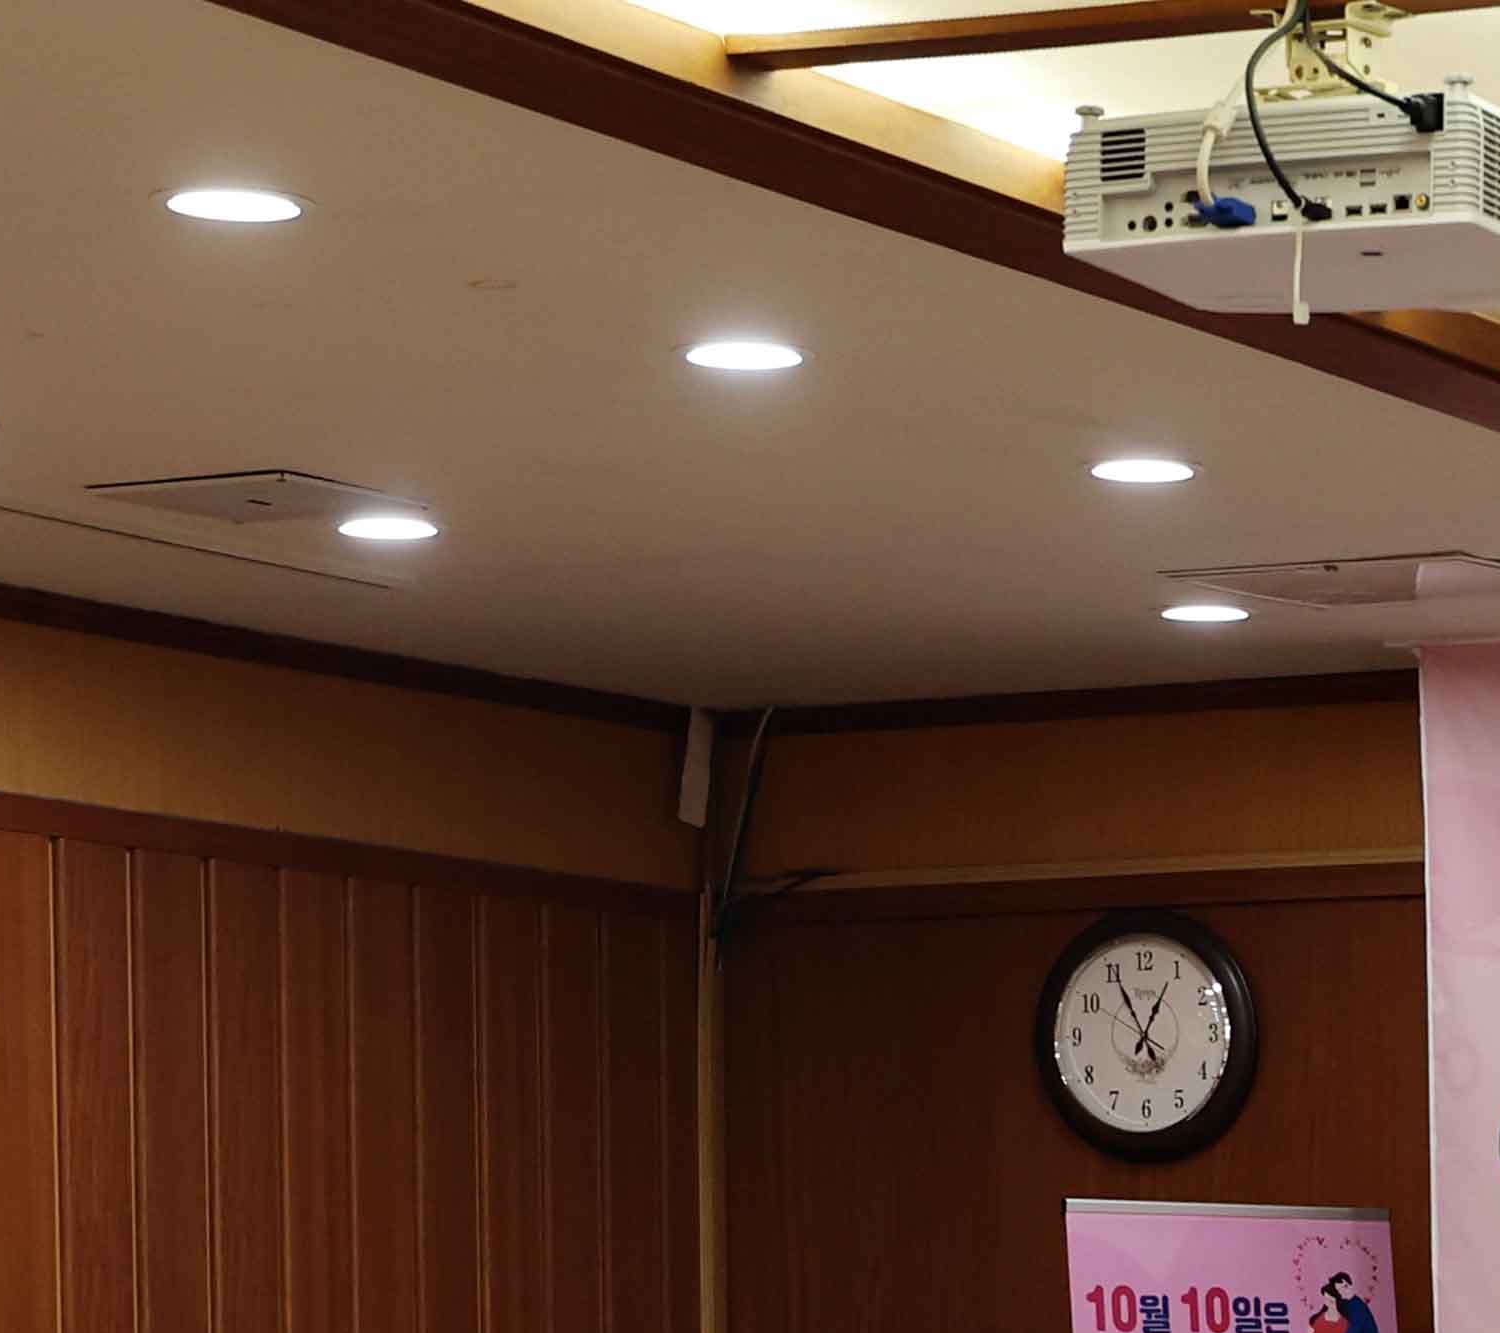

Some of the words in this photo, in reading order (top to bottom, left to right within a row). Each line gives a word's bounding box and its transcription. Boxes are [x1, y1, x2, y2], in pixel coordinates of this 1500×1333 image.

[1135, 951, 1153, 971] 12
[1173, 961, 1181, 979] 1
[1106, 964, 1121, 983] 11
[1082, 994, 1100, 1014] 10
[1072, 1027, 1082, 1046] 9
[1209, 1023, 1219, 1042] 3
[1084, 1065, 1094, 1085] 8
[1198, 1061, 1207, 1080] 4
[1109, 1090, 1119, 1110] 7
[1141, 1099, 1151, 1118] 6
[1174, 1089, 1184, 1109] 5
